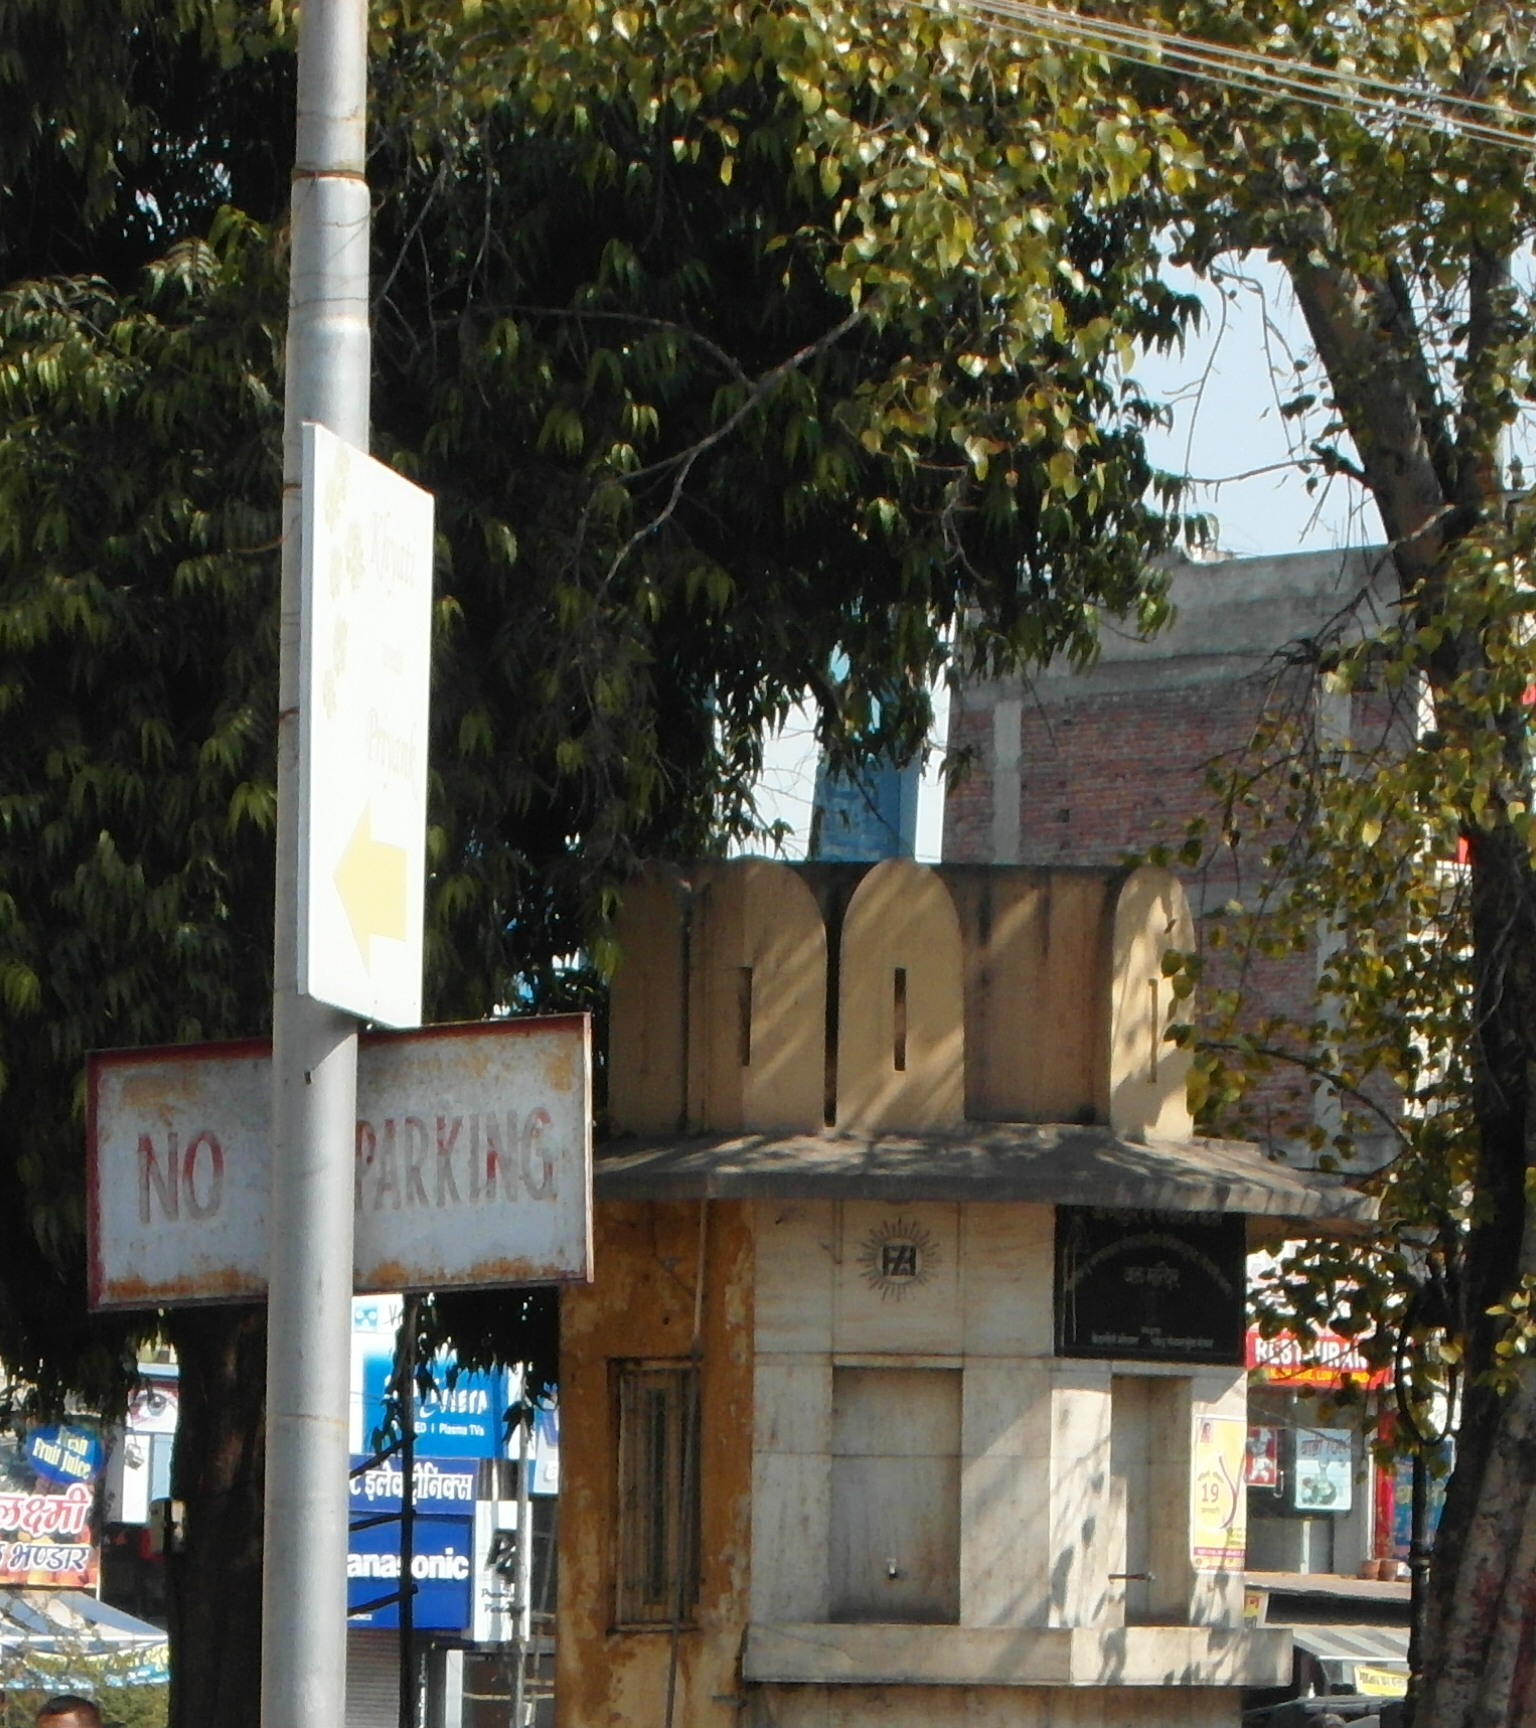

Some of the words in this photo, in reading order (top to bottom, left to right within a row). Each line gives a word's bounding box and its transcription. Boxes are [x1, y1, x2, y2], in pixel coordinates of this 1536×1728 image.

[137, 1130, 225, 1225] NO
[355, 1106, 559, 1212] PARKING
[32, 1436, 62, 1466] Fruit
[1200, 1482, 1220, 1503] 19
[10, 1543, 90, 1573] भण्डार
[347, 1546, 470, 1580] anaonic
